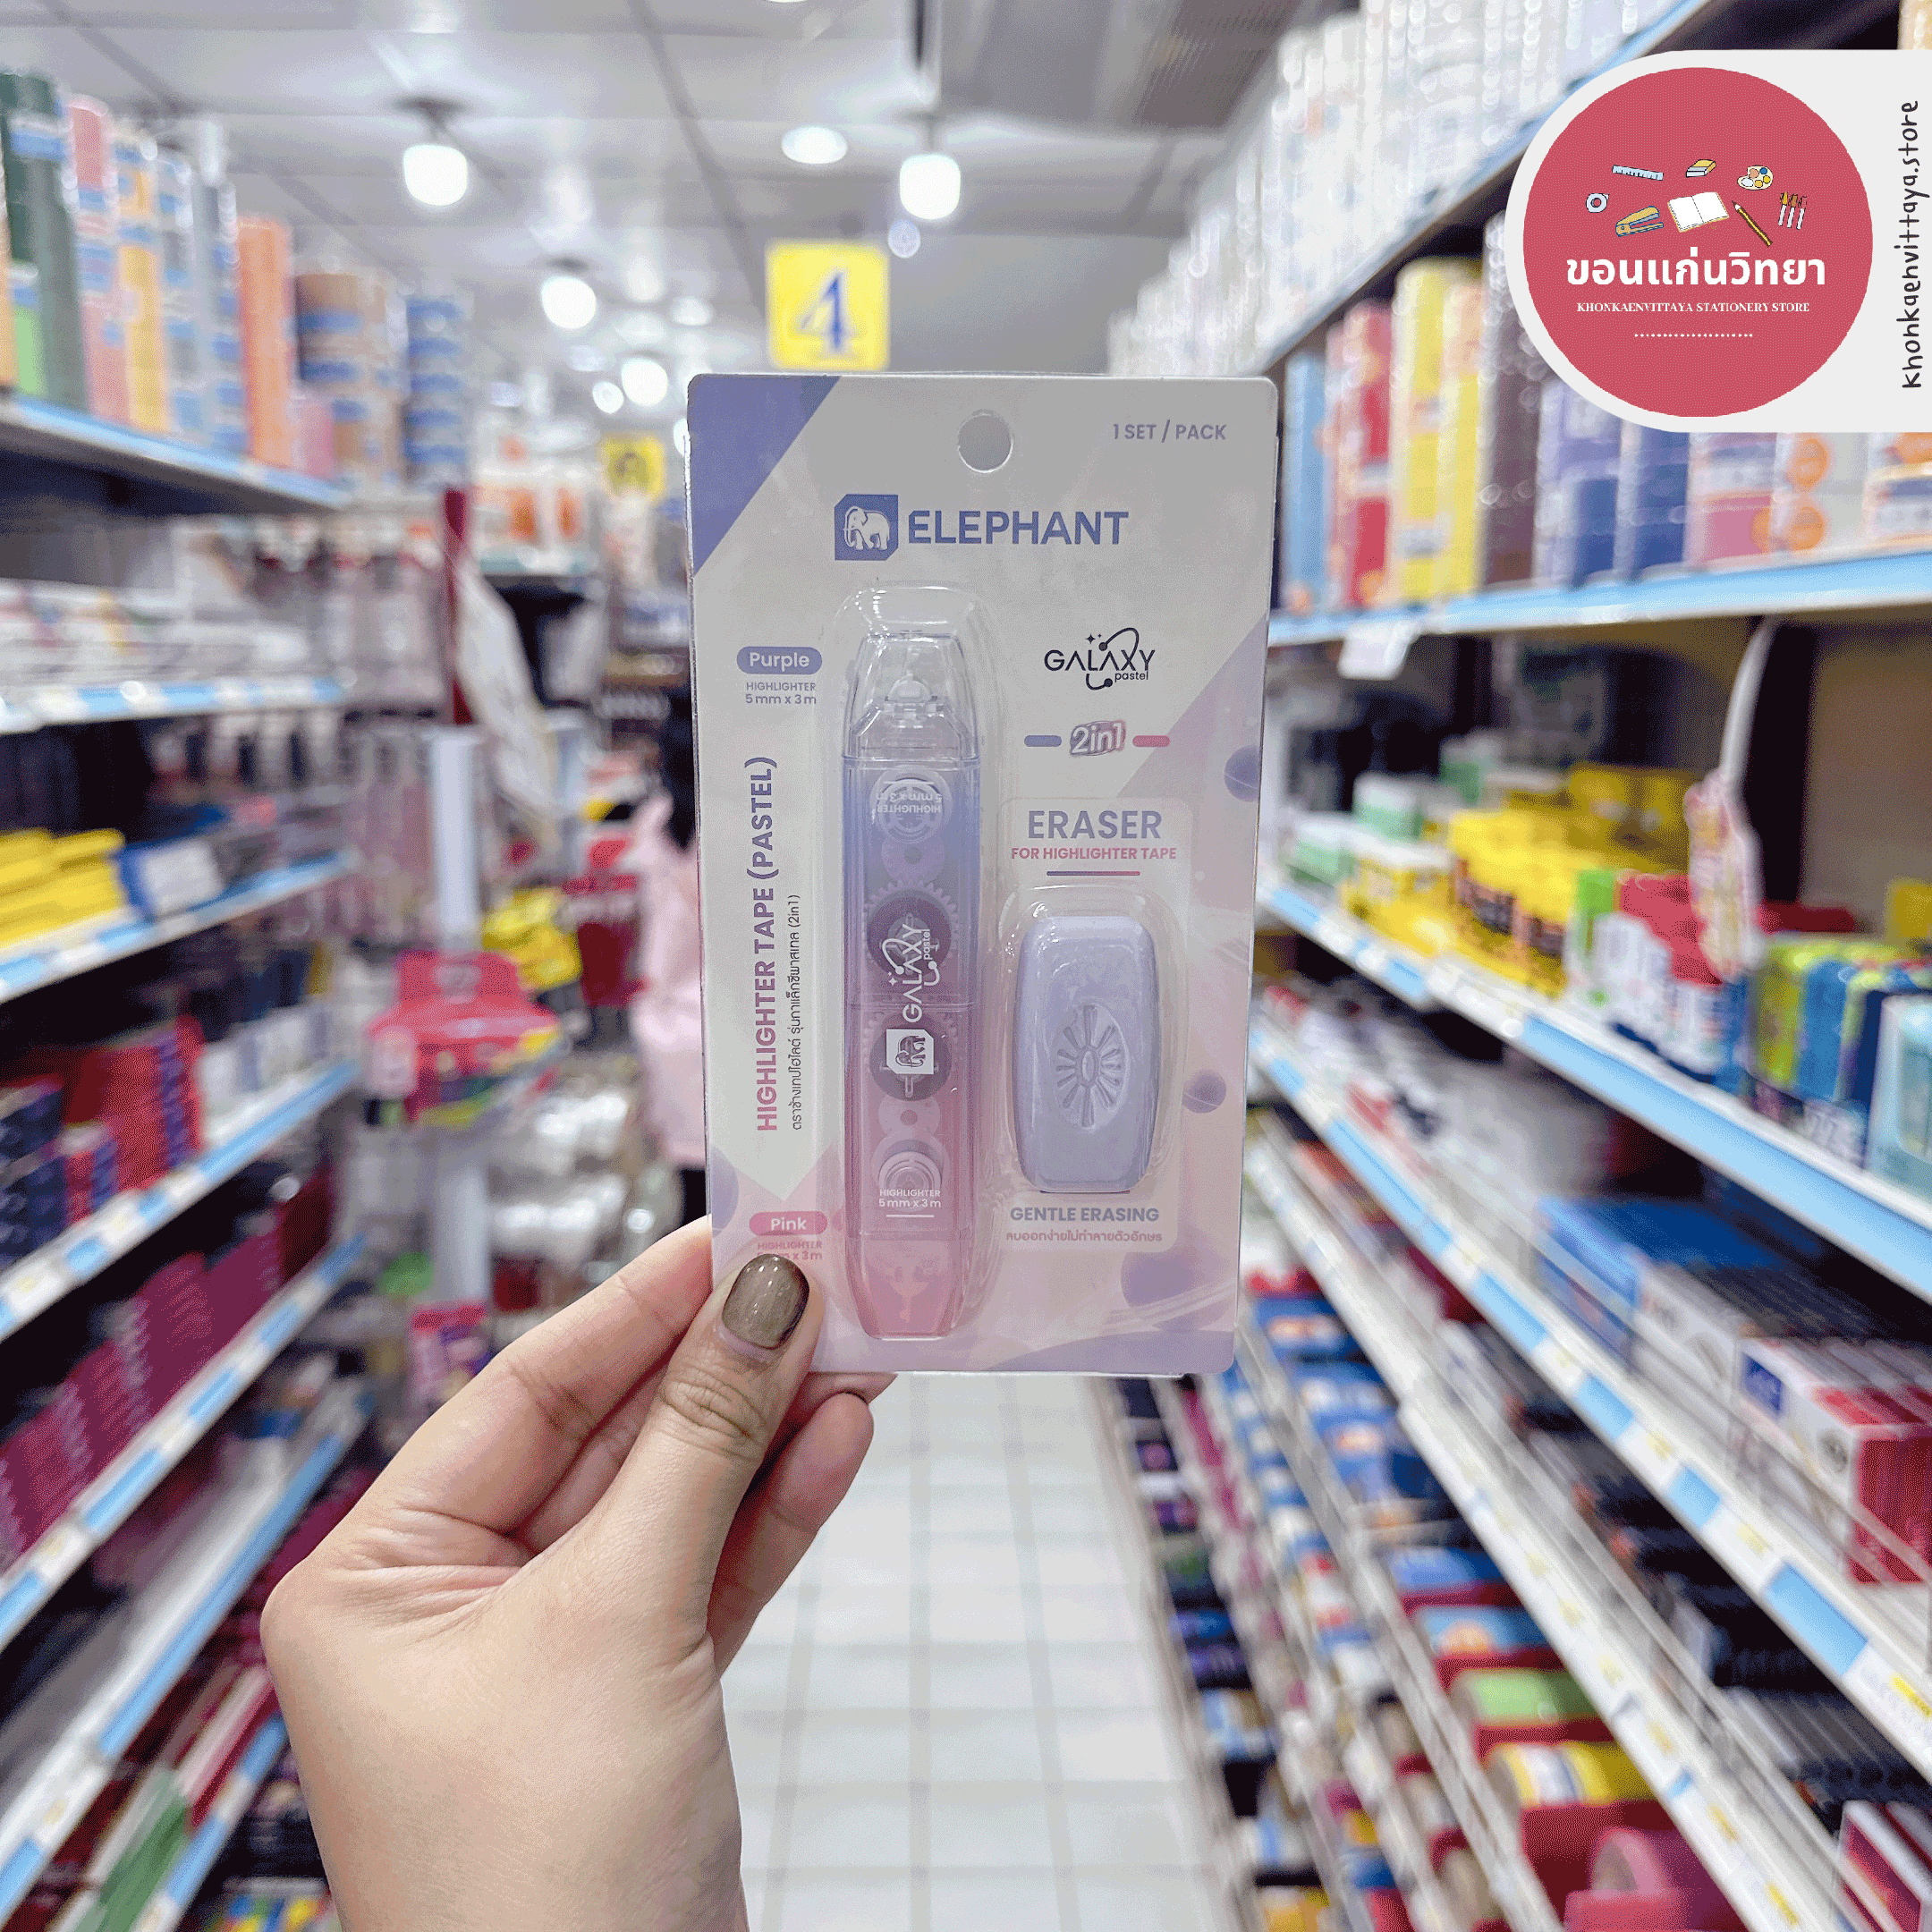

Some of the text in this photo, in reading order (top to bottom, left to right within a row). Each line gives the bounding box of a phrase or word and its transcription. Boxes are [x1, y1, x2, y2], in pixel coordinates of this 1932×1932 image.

[1114, 424, 1119, 439] 1
[1124, 424, 1157, 440] SET
[1175, 424, 1226, 440] PACK
[908, 510, 1129, 545] ELEPHANT
[749, 652, 810, 672] Purple
[1044, 649, 1156, 672] GALAXY
[1114, 671, 1148, 682] pastel
[746, 682, 817, 691] HIGHLIGHTER
[1072, 723, 1123, 754] 2in1
[876, 804, 942, 813] HIGHLIGHTER
[1029, 810, 1162, 839] ERASER
[1011, 848, 1177, 860] FOR HIGHLIGHTER TAPE
[788, 894, 801, 928] (2in1)
[744, 757, 779, 1131] HIGHLIGHTER TAPE (PASTEL)
[921, 928, 932, 961] pastel
[879, 1189, 941, 1198] HIGHLIGHTER
[1010, 1207, 1159, 1222] GENTLE ERASING
[770, 1217, 807, 1231] Pink
[757, 1241, 823, 1250] HIGHLIGHTER
